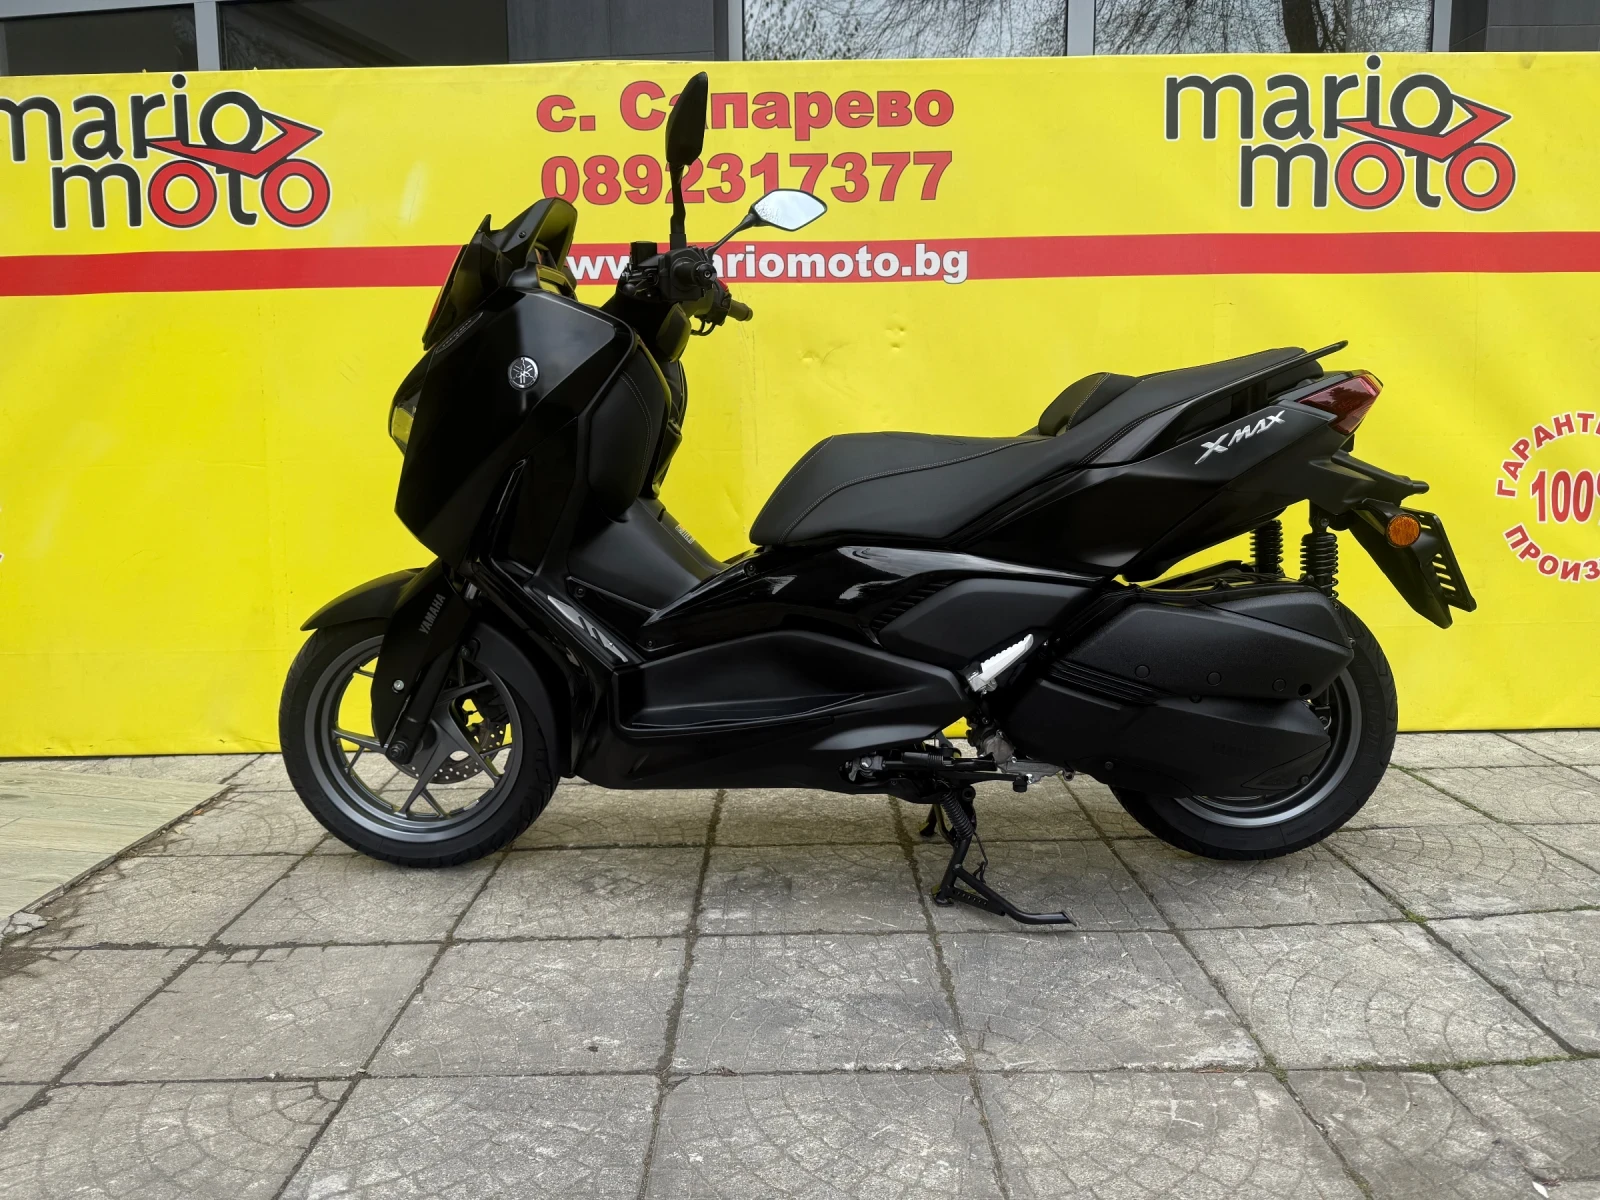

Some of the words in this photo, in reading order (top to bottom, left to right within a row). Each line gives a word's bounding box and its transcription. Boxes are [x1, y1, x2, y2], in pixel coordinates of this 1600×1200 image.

[536, 95, 596, 132] с.
[620, 80, 955, 141] Спарево
[1165, 54, 1454, 140] mario
[52, 158, 331, 229] moto
[541, 150, 953, 205] 0892317377
[1239, 140, 1515, 211] moto
[1497, 412, 1600, 497] ГАРАНТ
[1531, 470, 1600, 523] 100
[418, 593, 446, 635] YAMAHA
